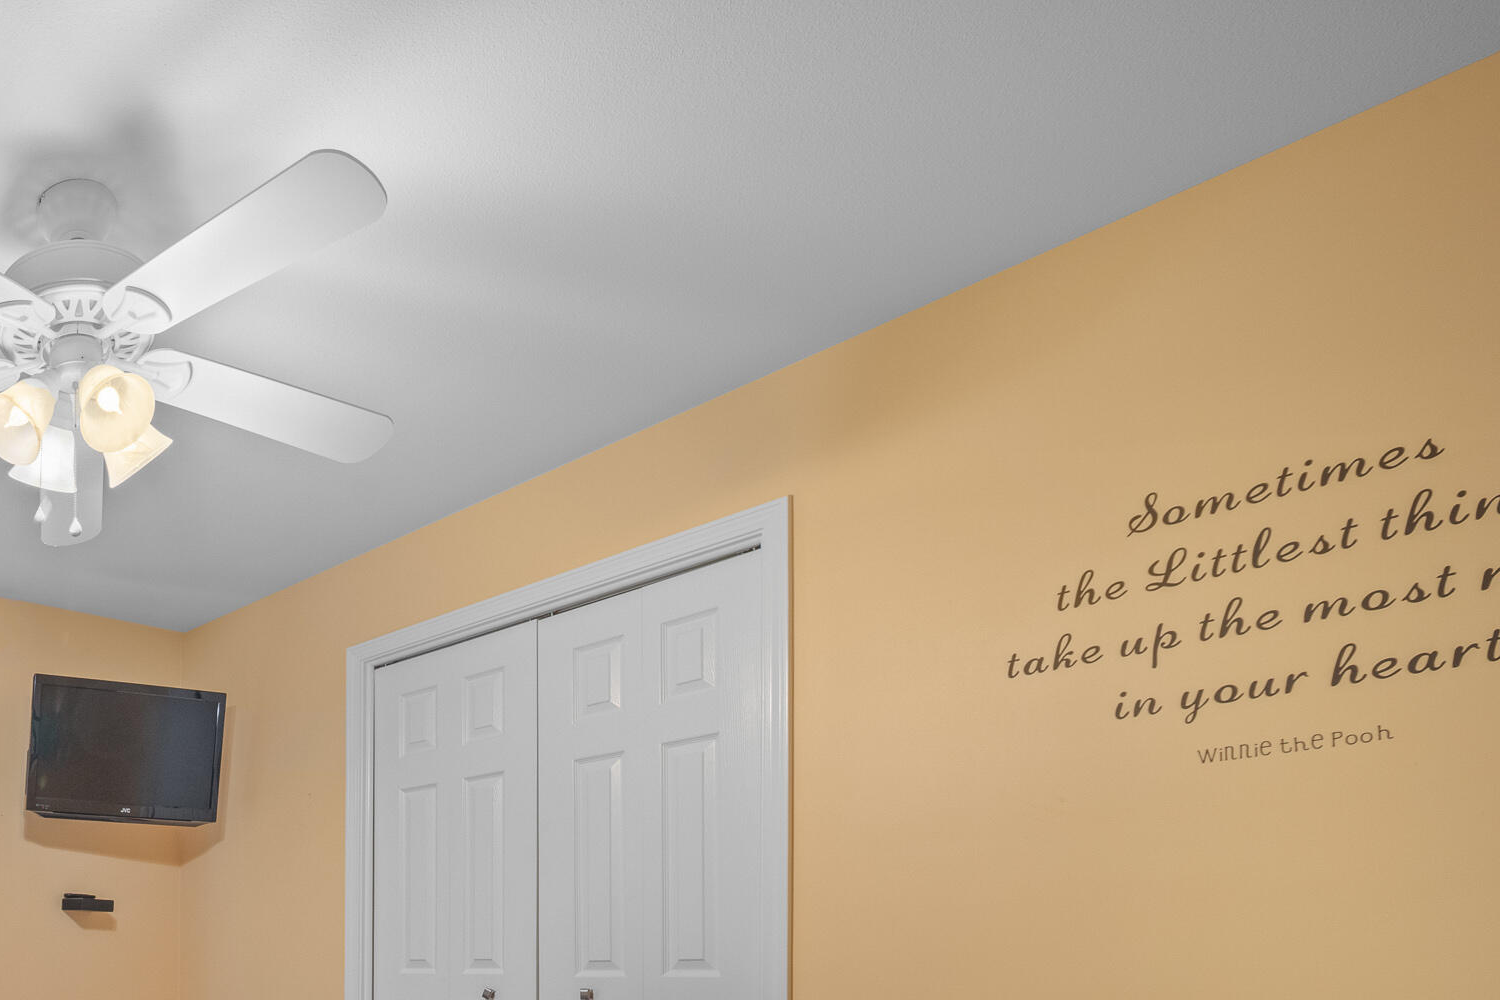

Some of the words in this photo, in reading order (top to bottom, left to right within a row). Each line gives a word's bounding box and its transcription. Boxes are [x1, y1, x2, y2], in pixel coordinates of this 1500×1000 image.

[1126, 438, 1445, 537] Sometimes
[1056, 569, 1128, 612] the
[1145, 517, 1358, 592] Littlest
[1006, 632, 1104, 679] take
[1119, 622, 1182, 669] up
[1198, 596, 1283, 643] the
[1303, 564, 1456, 624] most
[1114, 690, 1163, 720] in
[1180, 670, 1308, 725] your
[1330, 628, 1500, 688] heart
[1279, 731, 1325, 755] the
[1331, 724, 1395, 748] Pooh
